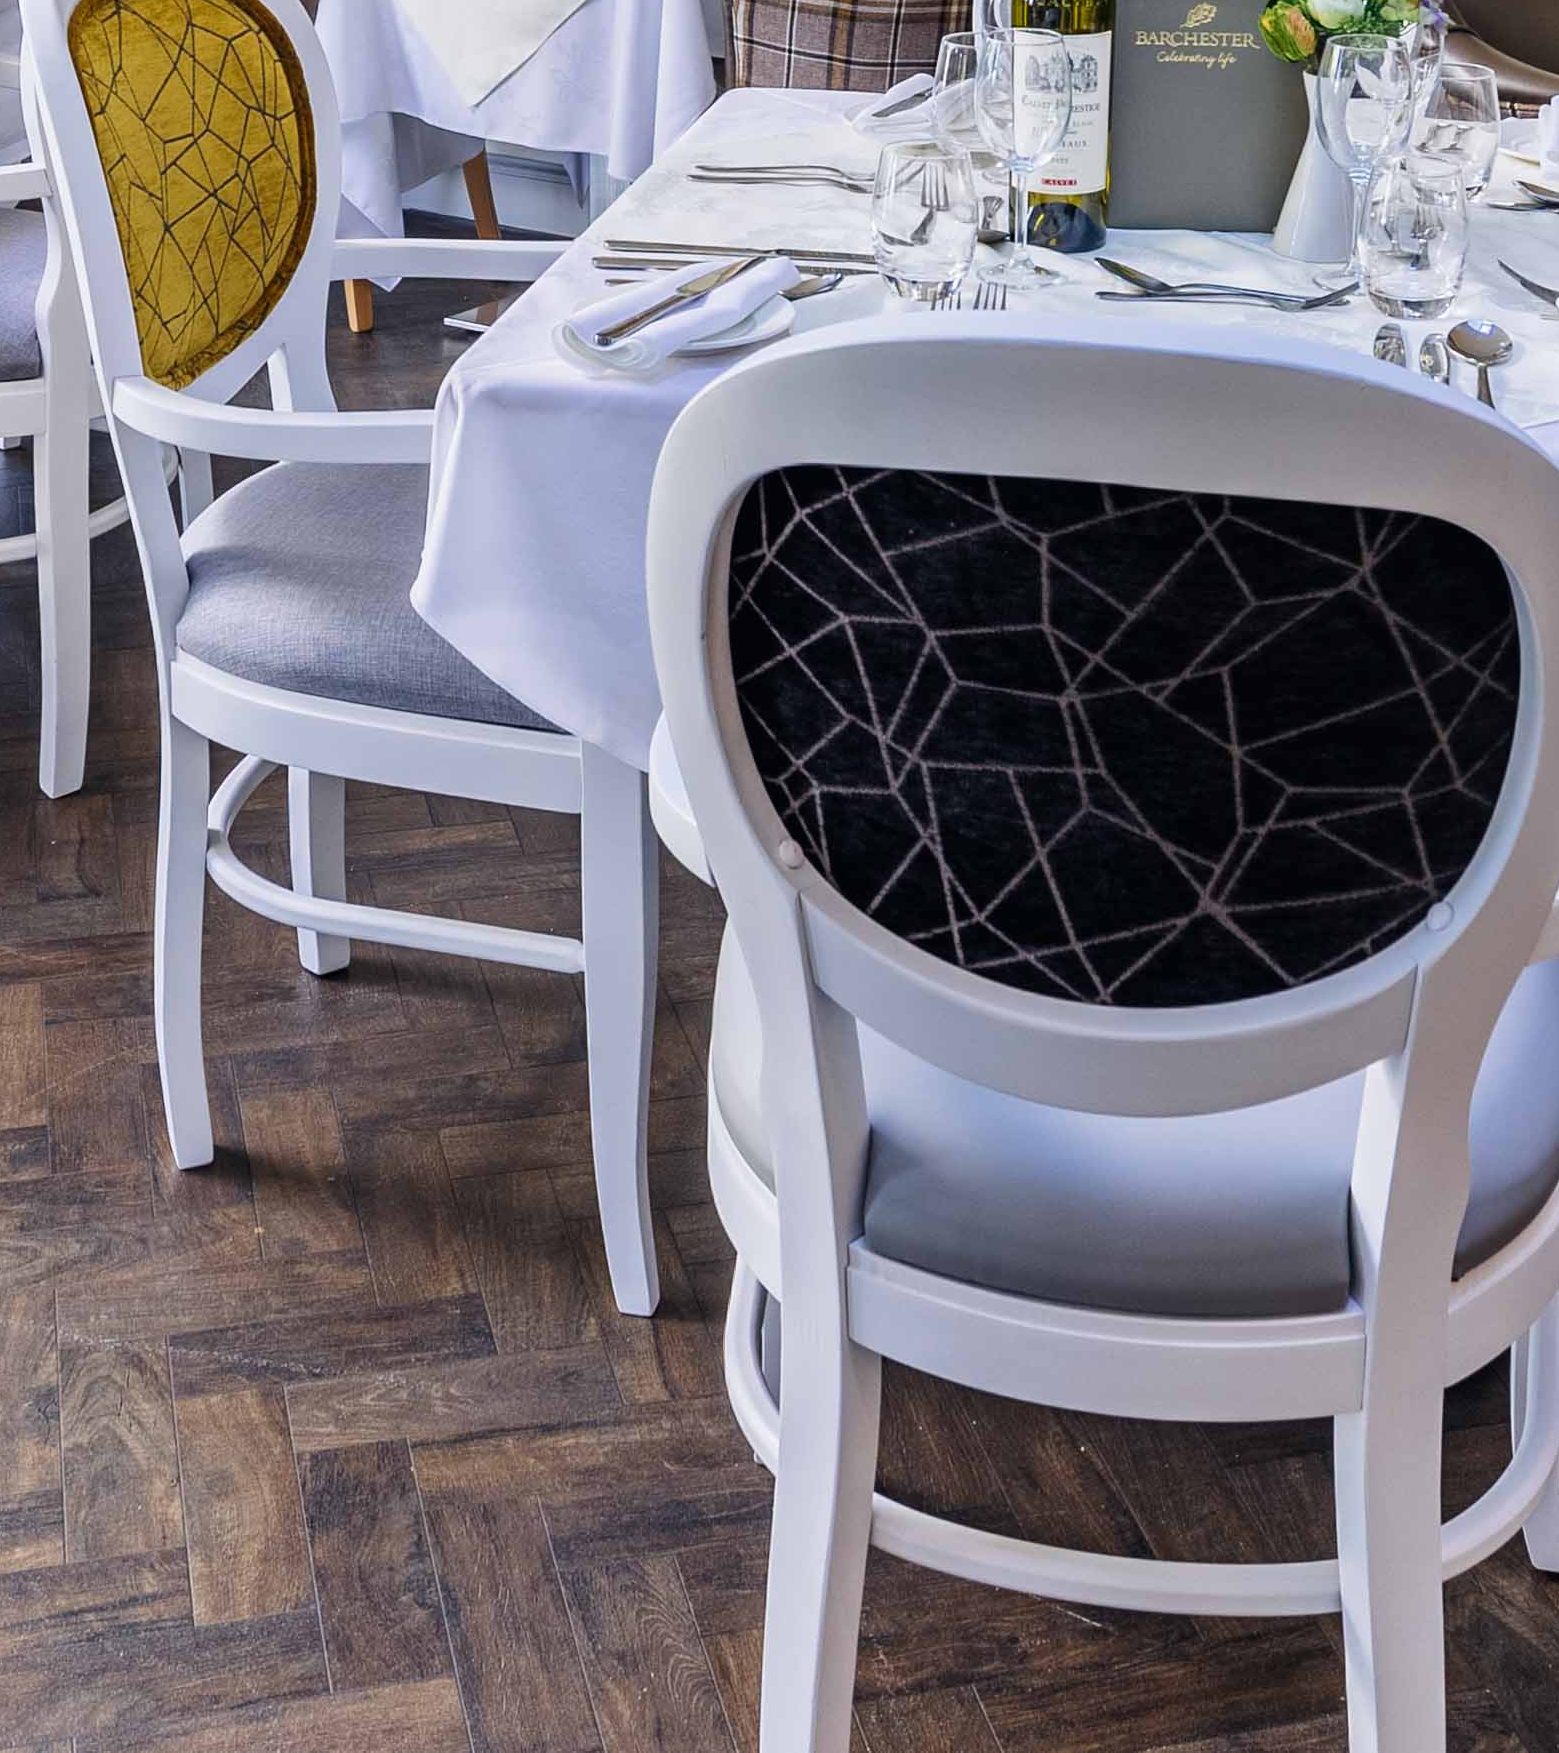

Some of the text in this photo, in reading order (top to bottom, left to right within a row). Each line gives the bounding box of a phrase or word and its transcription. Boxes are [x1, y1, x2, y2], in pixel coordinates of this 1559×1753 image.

[1135, 31, 1261, 49] BARCHESTER
[1156, 50, 1237, 70] Celebrating life
